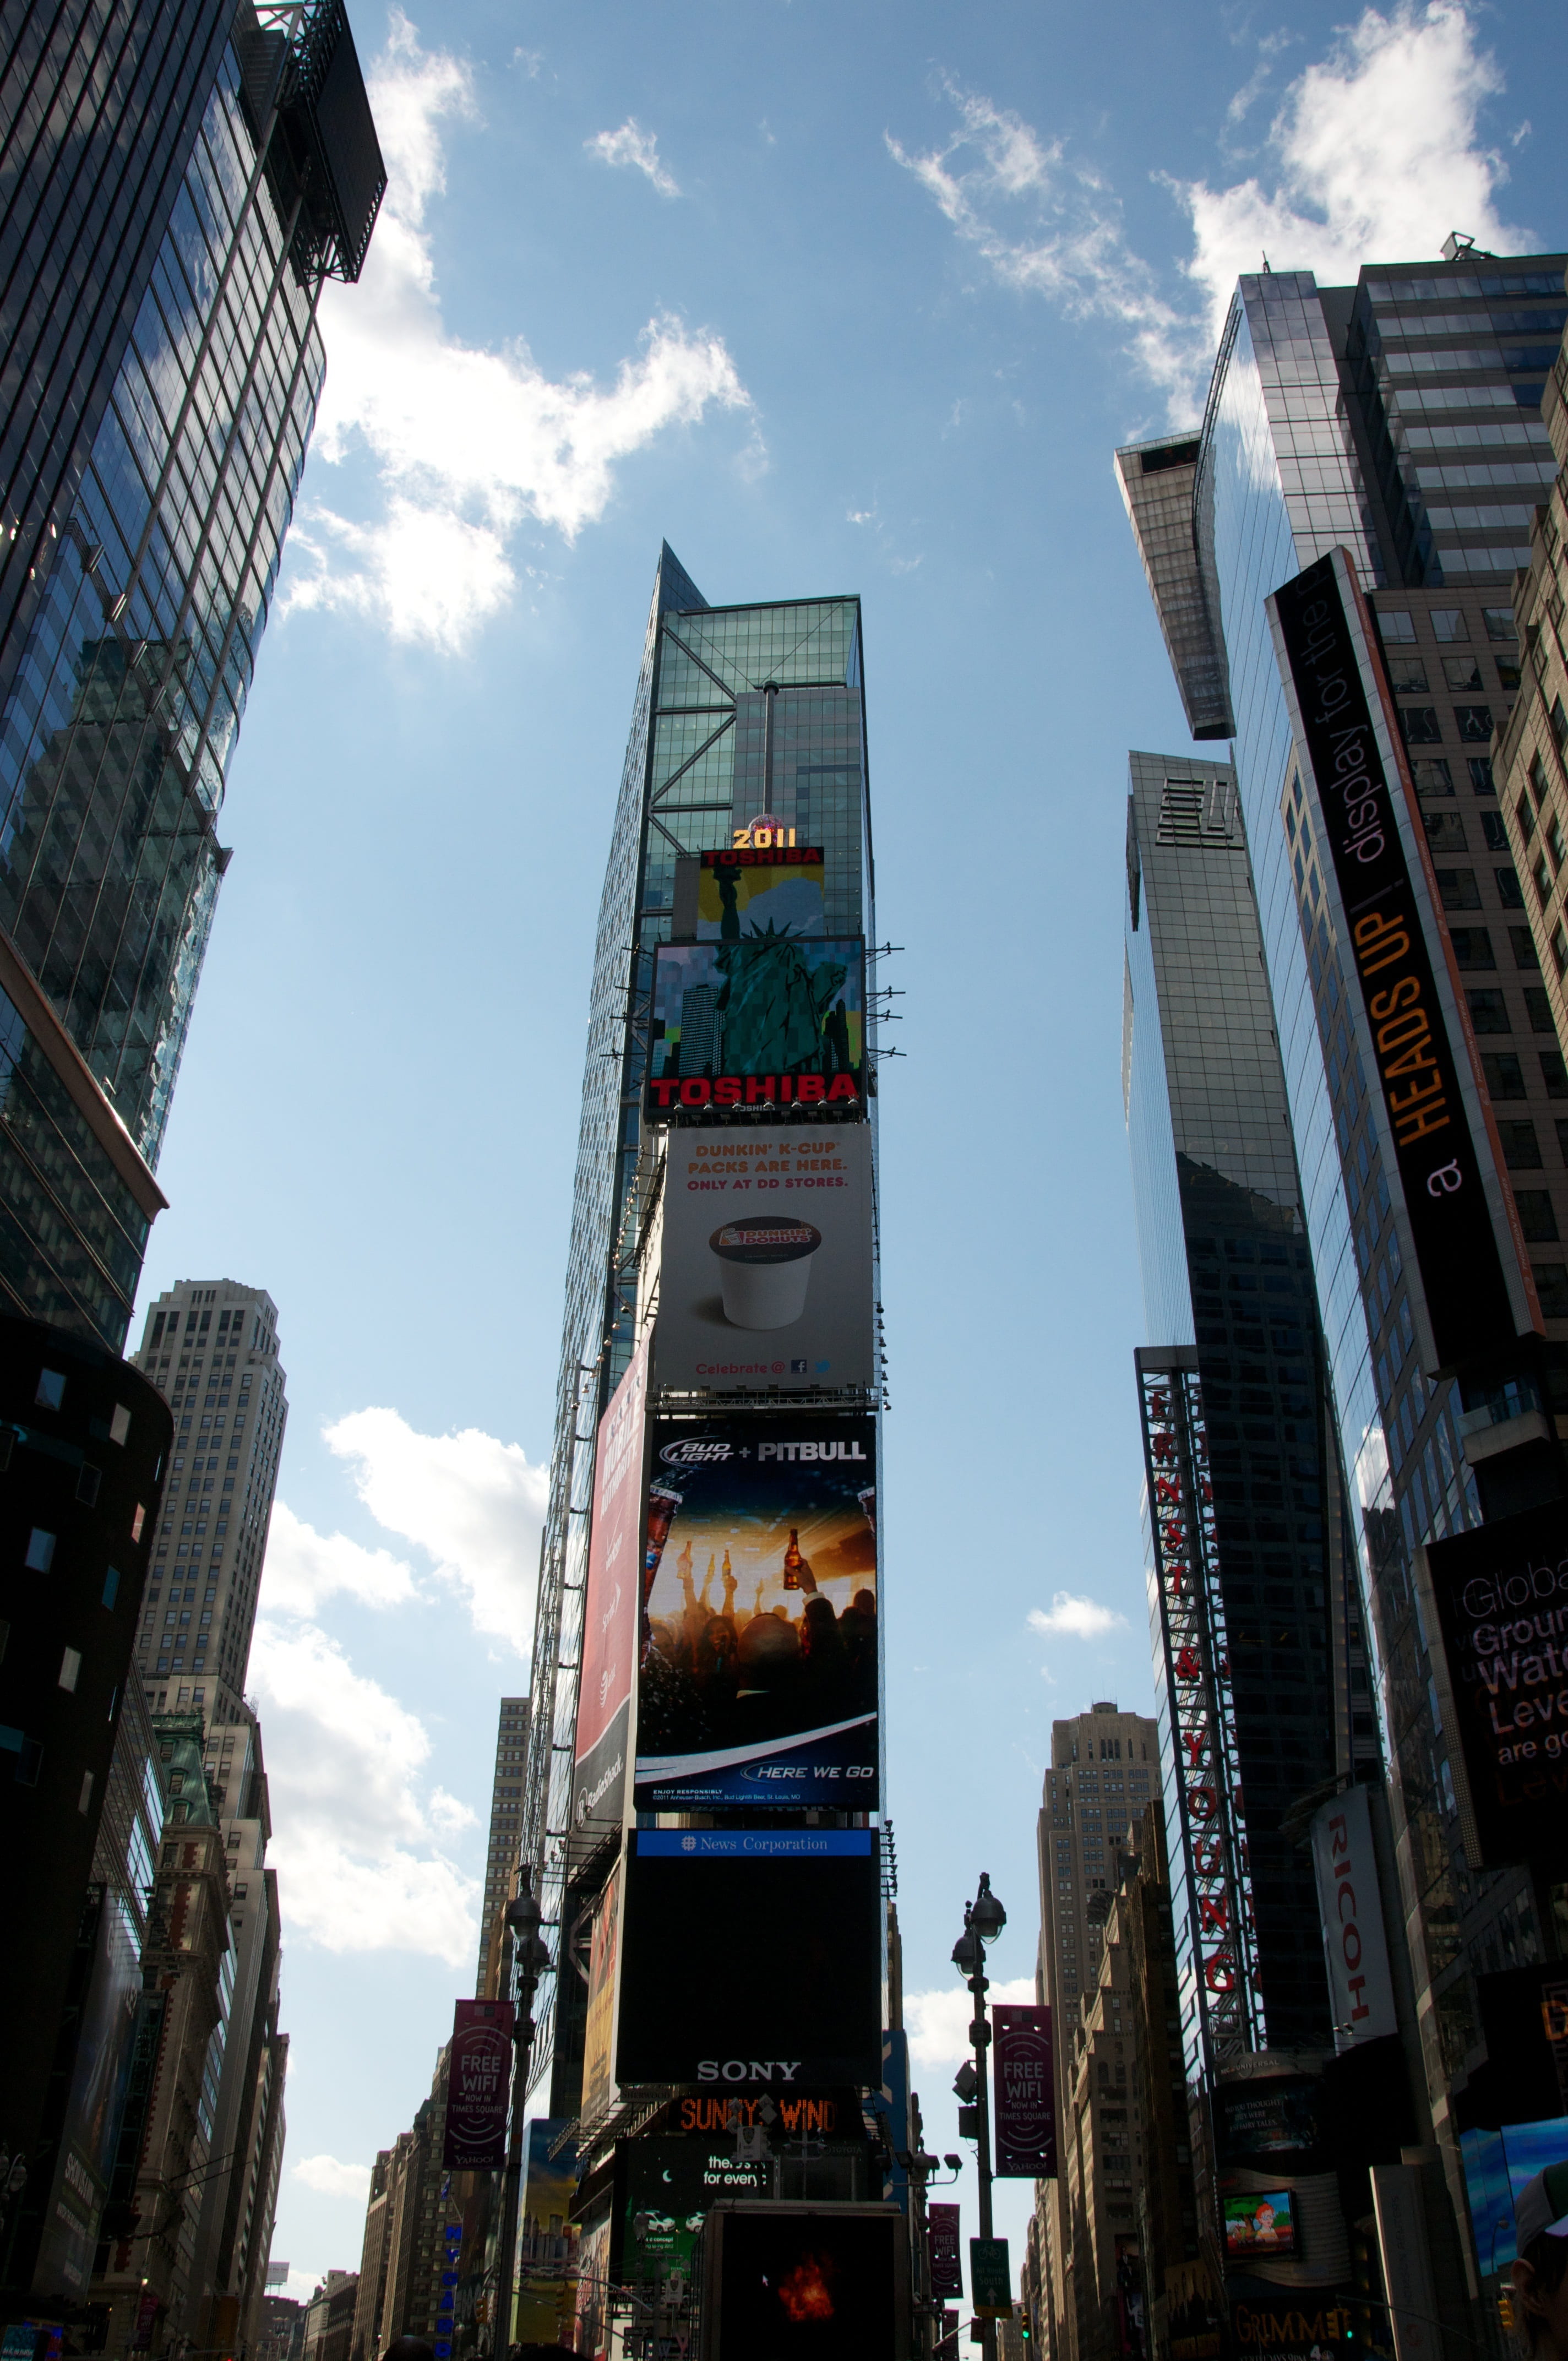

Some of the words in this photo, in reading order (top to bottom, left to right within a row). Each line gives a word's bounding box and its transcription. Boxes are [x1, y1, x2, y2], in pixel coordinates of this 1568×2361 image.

[1300, 599, 1336, 666] the
[1315, 667, 1352, 723] for
[1383, 697, 1396, 730] REUTERS
[1390, 732, 1404, 765] THOMSON
[1330, 723, 1386, 864] display
[733, 828, 796, 849] 2011
[704, 848, 820, 866] TOSHIBA
[1419, 840, 1433, 877] REUTERS
[1429, 878, 1442, 915] THOMSON
[1353, 911, 1409, 978] UP
[1458, 998, 1472, 1037] REUTERS
[1369, 976, 1451, 1147] HEADS
[1468, 1040, 1482, 1082] THOMSON
[650, 1073, 859, 1107] TOSHIBA
[696, 1144, 772, 1157] DUNKIN'
[688, 1161, 748, 1174] PACKS
[755, 1160, 790, 1172] ARE
[797, 1158, 847, 1171] HERE.
[688, 1180, 727, 1191] ONLY
[733, 1179, 752, 1190] AT
[757, 1179, 779, 1189] DD
[785, 1177, 848, 1188] STORES.
[1502, 1175, 1516, 1219] REUTERS
[745, 1236, 809, 1244] DONUTS
[1513, 1222, 1528, 1270] THOMSON
[696, 1363, 767, 1374] Celebrate
[771, 1361, 786, 1374] @
[602, 1387, 642, 1492] MOBILE
[680, 1443, 731, 1452] BUD
[668, 1452, 734, 1462] LIGHT
[758, 1441, 867, 1461] PITBULL
[1151, 1390, 1185, 1596] ERNST
[1175, 1646, 1201, 1679] &
[1498, 1739, 1538, 1766] are
[587, 1753, 622, 1809] RadioShack
[757, 1767, 808, 1778] HERE
[814, 1767, 840, 1778] WE
[846, 1766, 874, 1778] GO
[700, 1837, 737, 1850] News
[743, 1836, 827, 1853] Corporation
[1184, 1732, 1234, 1994] YOUNG
[1329, 1813, 1369, 2021] RICOH
[460, 2055, 501, 2072] FREE
[696, 2060, 802, 2082] SONY
[1004, 2062, 1044, 2079] FREE
[1236, 2060, 1280, 2071] UNIVERSAL
[462, 2074, 497, 2092] WIFI
[1006, 2081, 1042, 2098] WIFI
[465, 2095, 482, 2103] NOW
[1011, 2101, 1029, 2109] NOW
[1030, 2101, 1038, 2109] IN
[451, 2104, 474, 2113] TIMES
[475, 2105, 504, 2114] SQUARE
[1022, 2112, 1051, 2121] SQUARE
[453, 2155, 494, 2165] YAHOO!
[1008, 2161, 1047, 2172] YAHOO!
[704, 2170, 722, 2185] for
[934, 2234, 956, 2245] FREE
[935, 2246, 954, 2256] WIFI
[979, 2277, 1004, 2286] South
[1236, 2304, 1327, 2348] GRIMM
